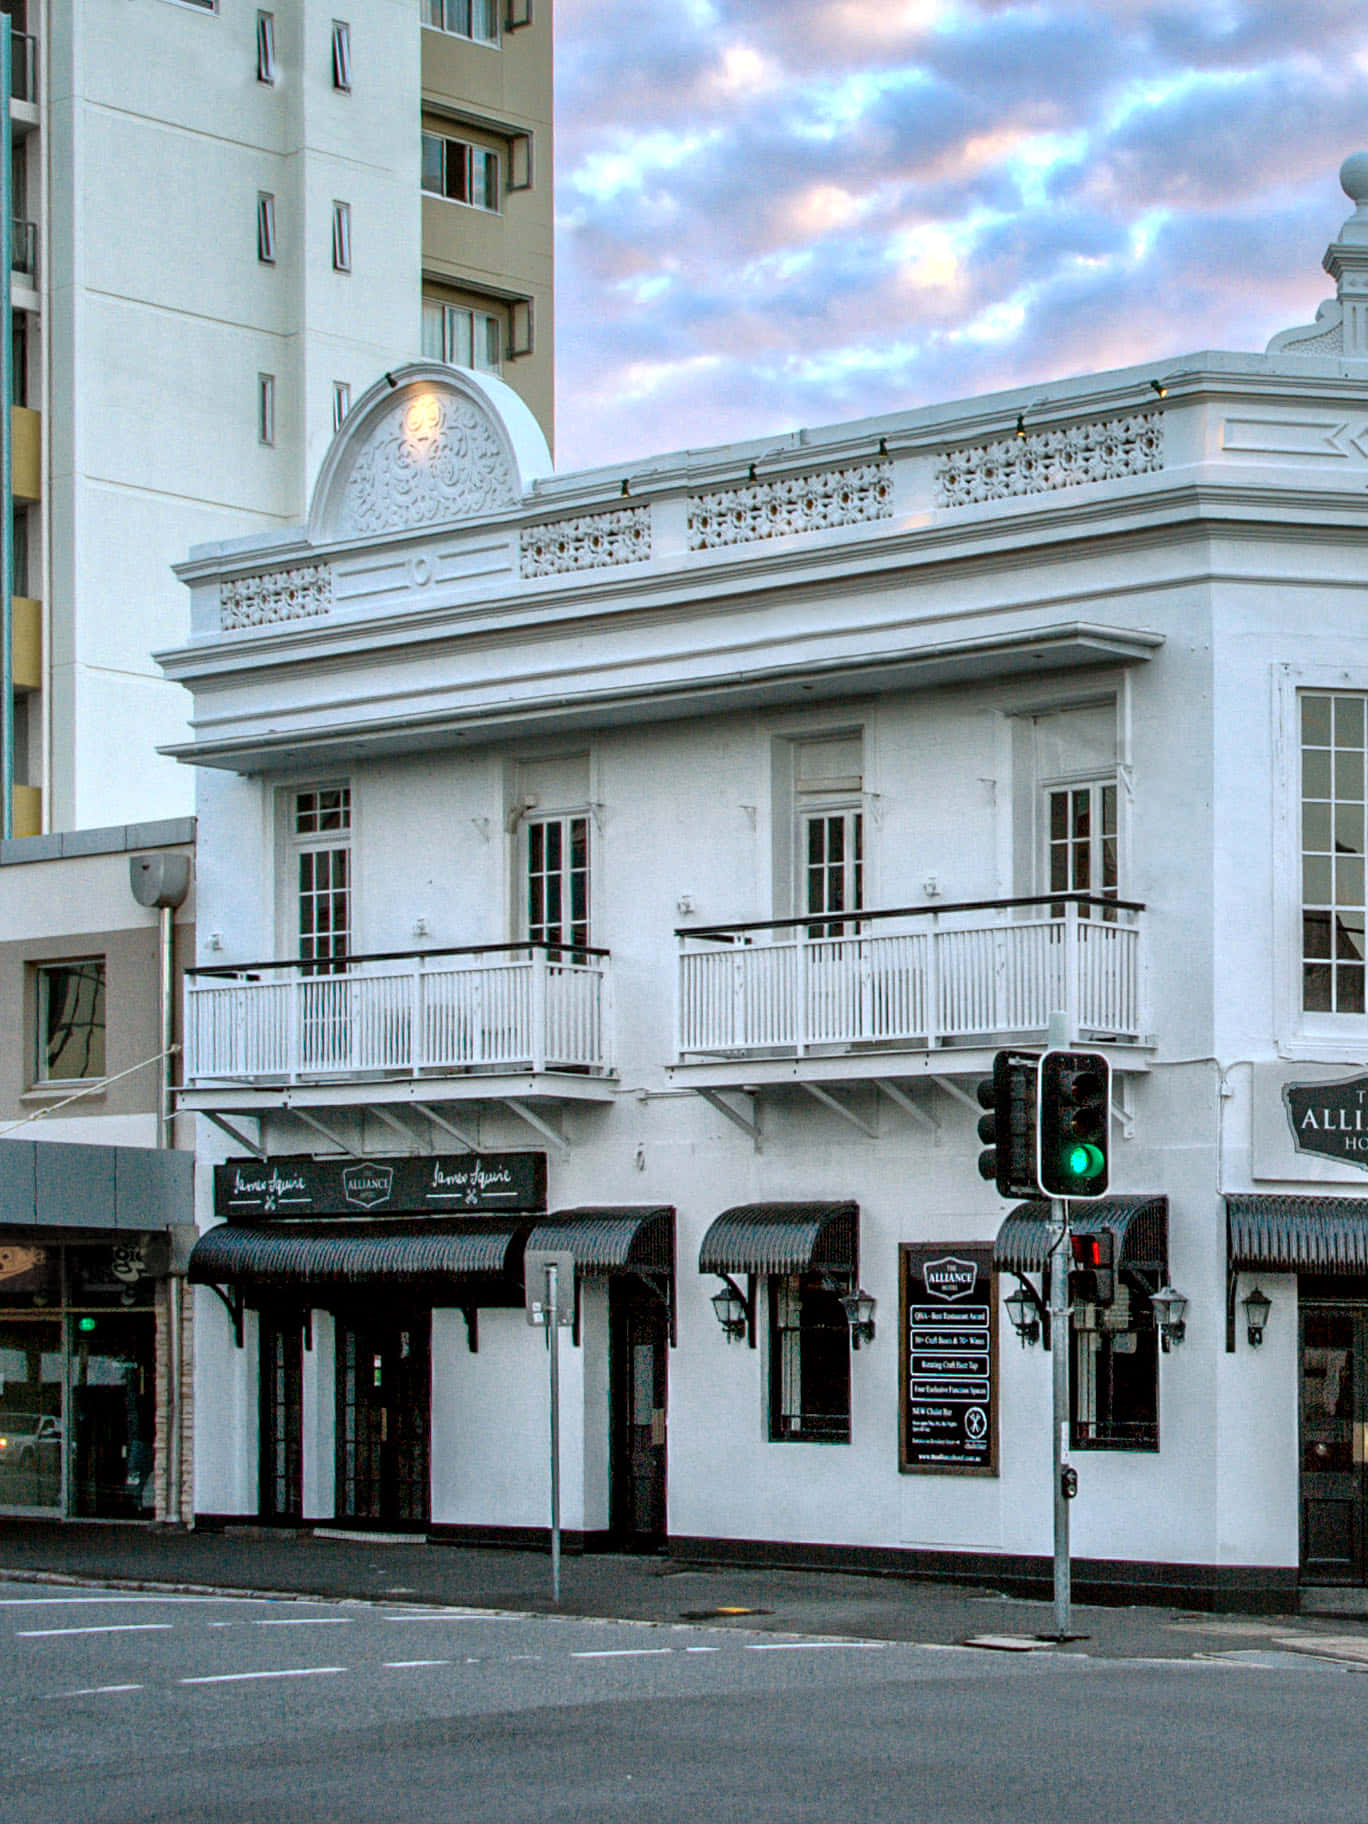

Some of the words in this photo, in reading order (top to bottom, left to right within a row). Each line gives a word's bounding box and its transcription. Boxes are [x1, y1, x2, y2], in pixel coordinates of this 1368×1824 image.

[234, 1169, 266, 1194] James
[268, 1168, 305, 1196] Squire
[348, 1178, 389, 1190] ALLIANCE
[433, 1160, 468, 1188] James
[470, 1160, 511, 1189] Squire
[929, 1272, 972, 1283] ALLIANCE
